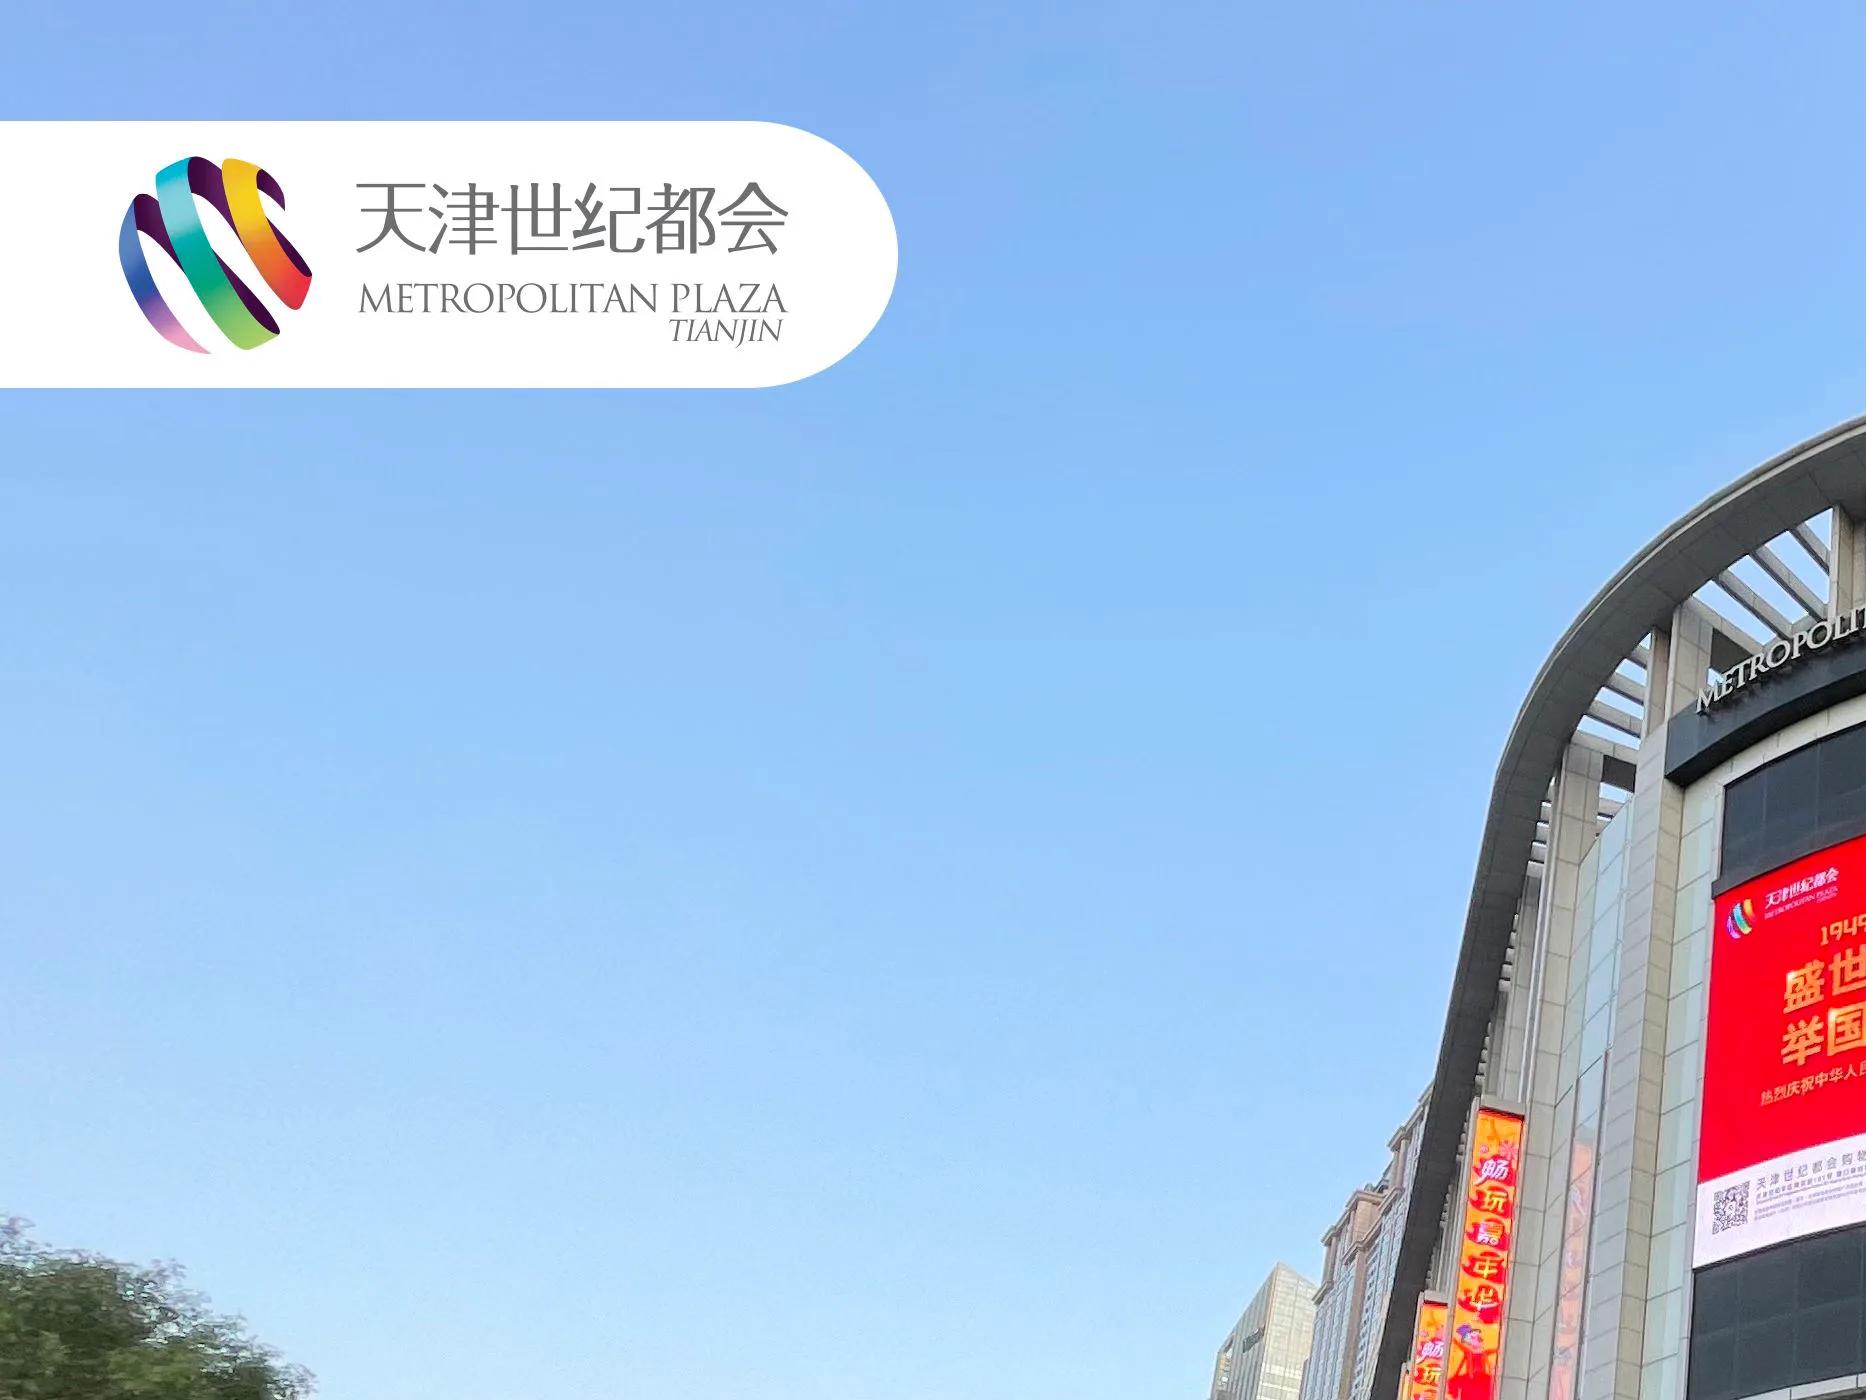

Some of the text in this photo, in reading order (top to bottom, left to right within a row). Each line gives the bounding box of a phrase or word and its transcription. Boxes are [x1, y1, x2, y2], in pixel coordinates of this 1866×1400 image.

[1765, 867, 1840, 909] 天津世纪都会
